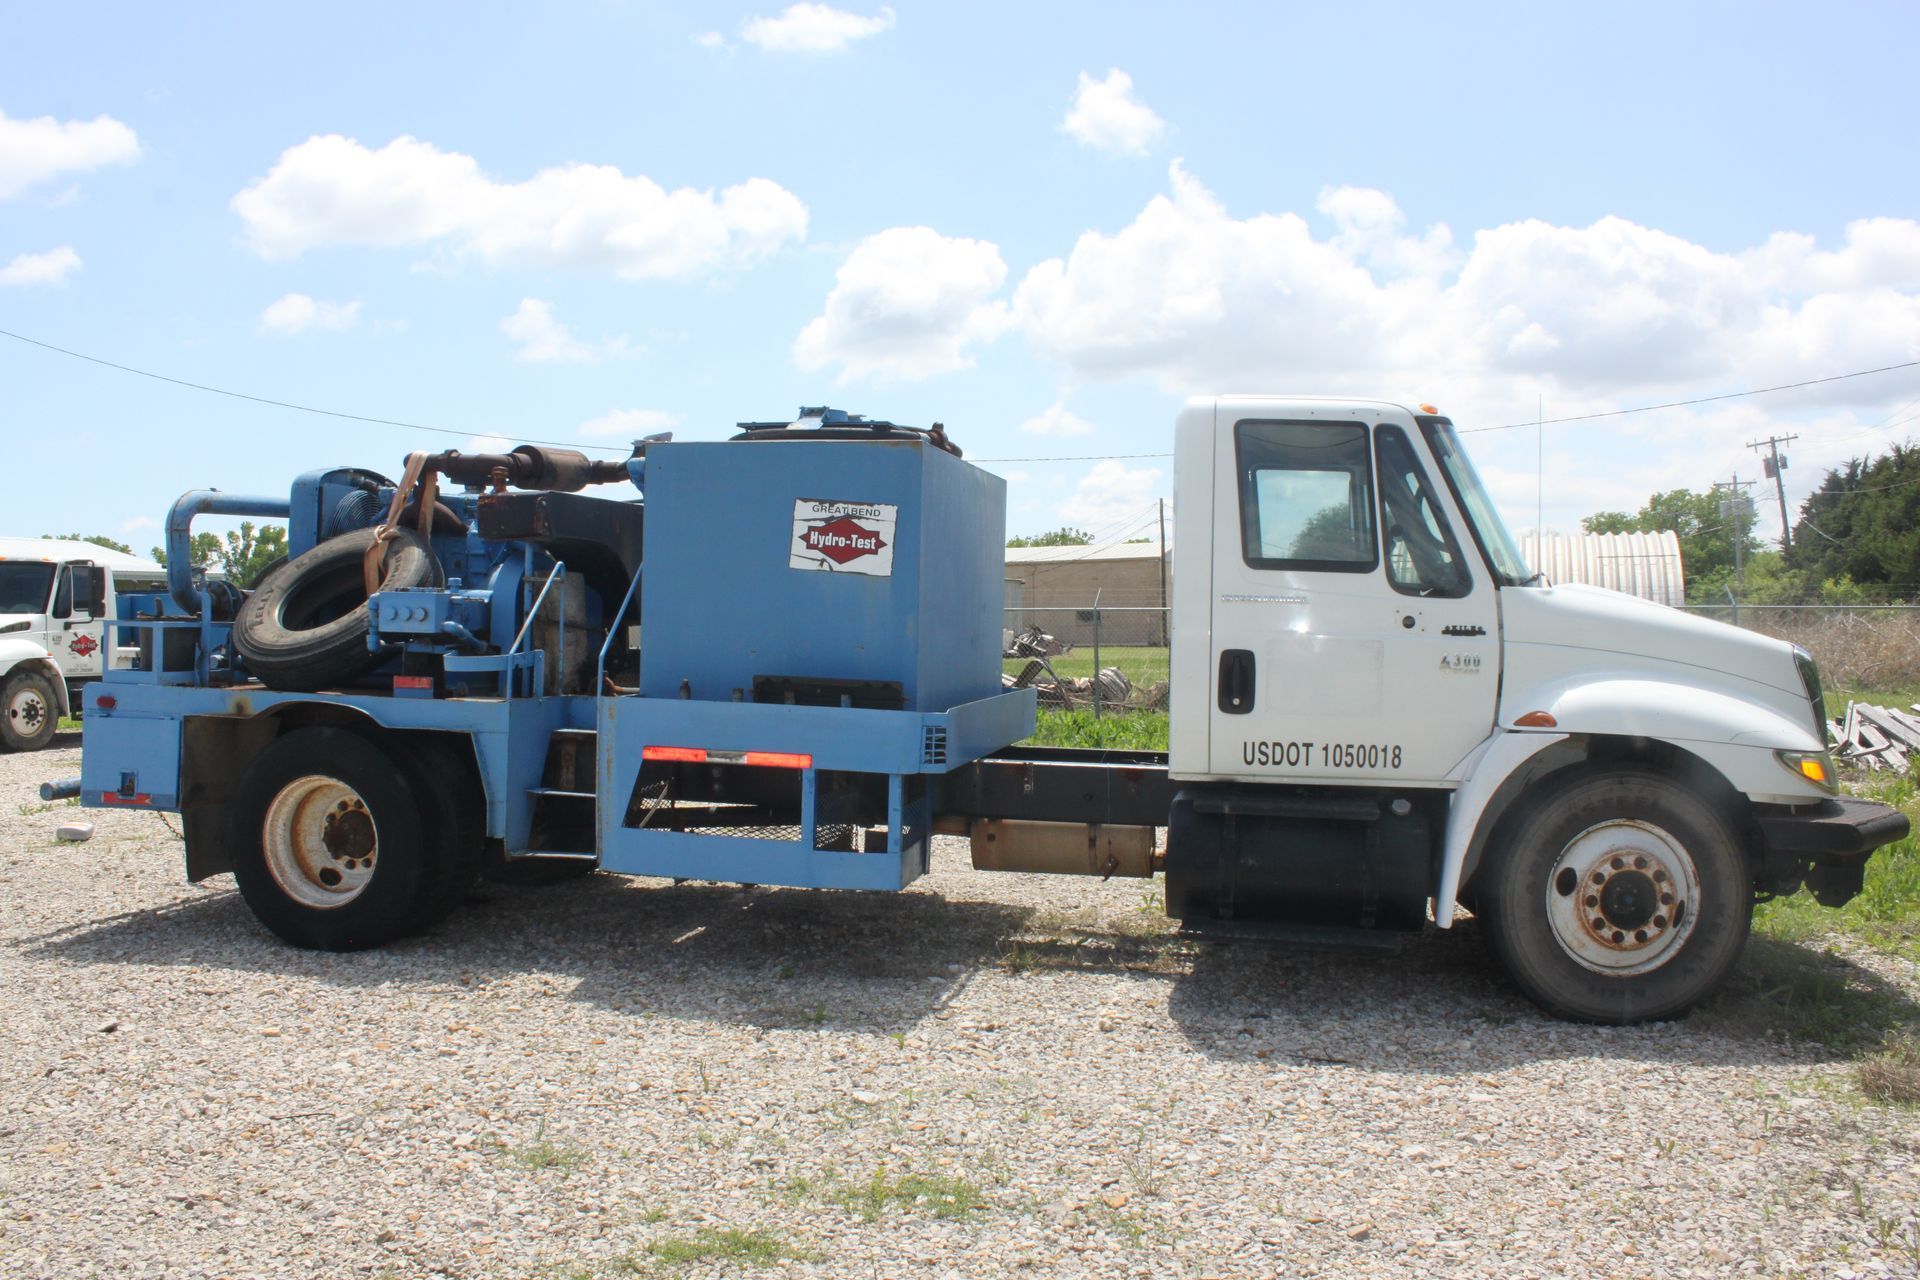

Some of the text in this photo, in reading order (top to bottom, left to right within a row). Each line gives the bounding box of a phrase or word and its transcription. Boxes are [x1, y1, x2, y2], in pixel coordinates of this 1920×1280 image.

[812, 504, 881, 517] GREAT BEND
[810, 531, 876, 550] Hydro-Test
[1243, 740, 1402, 769] USDOT 1050018
